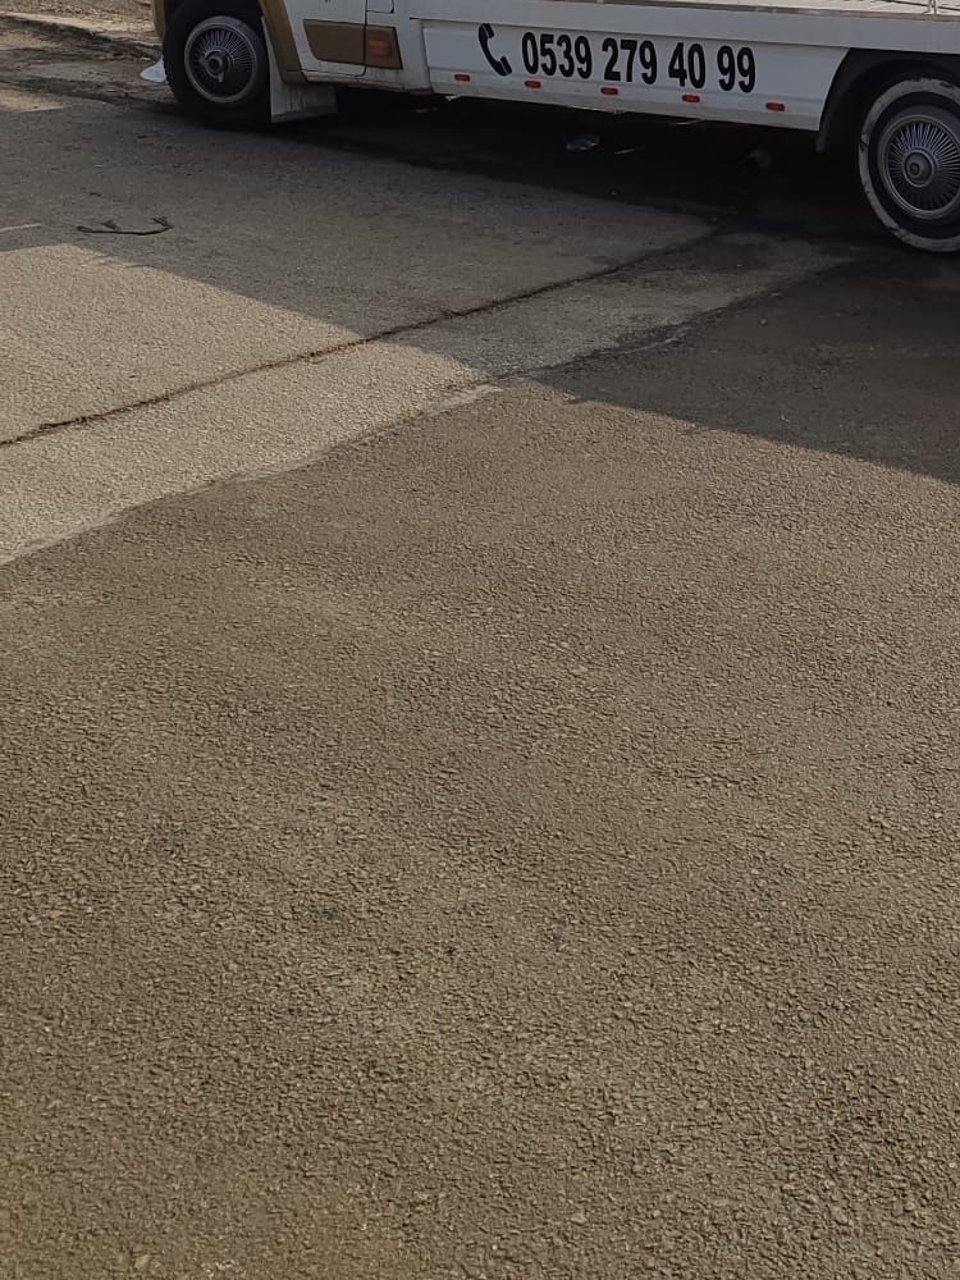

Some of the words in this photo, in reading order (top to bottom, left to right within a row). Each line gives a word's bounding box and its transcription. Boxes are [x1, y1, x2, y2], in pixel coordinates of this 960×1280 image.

[521, 31, 593, 79] 0539
[601, 37, 658, 85] 279
[668, 42, 707, 90] 40
[716, 45, 756, 93] 99
